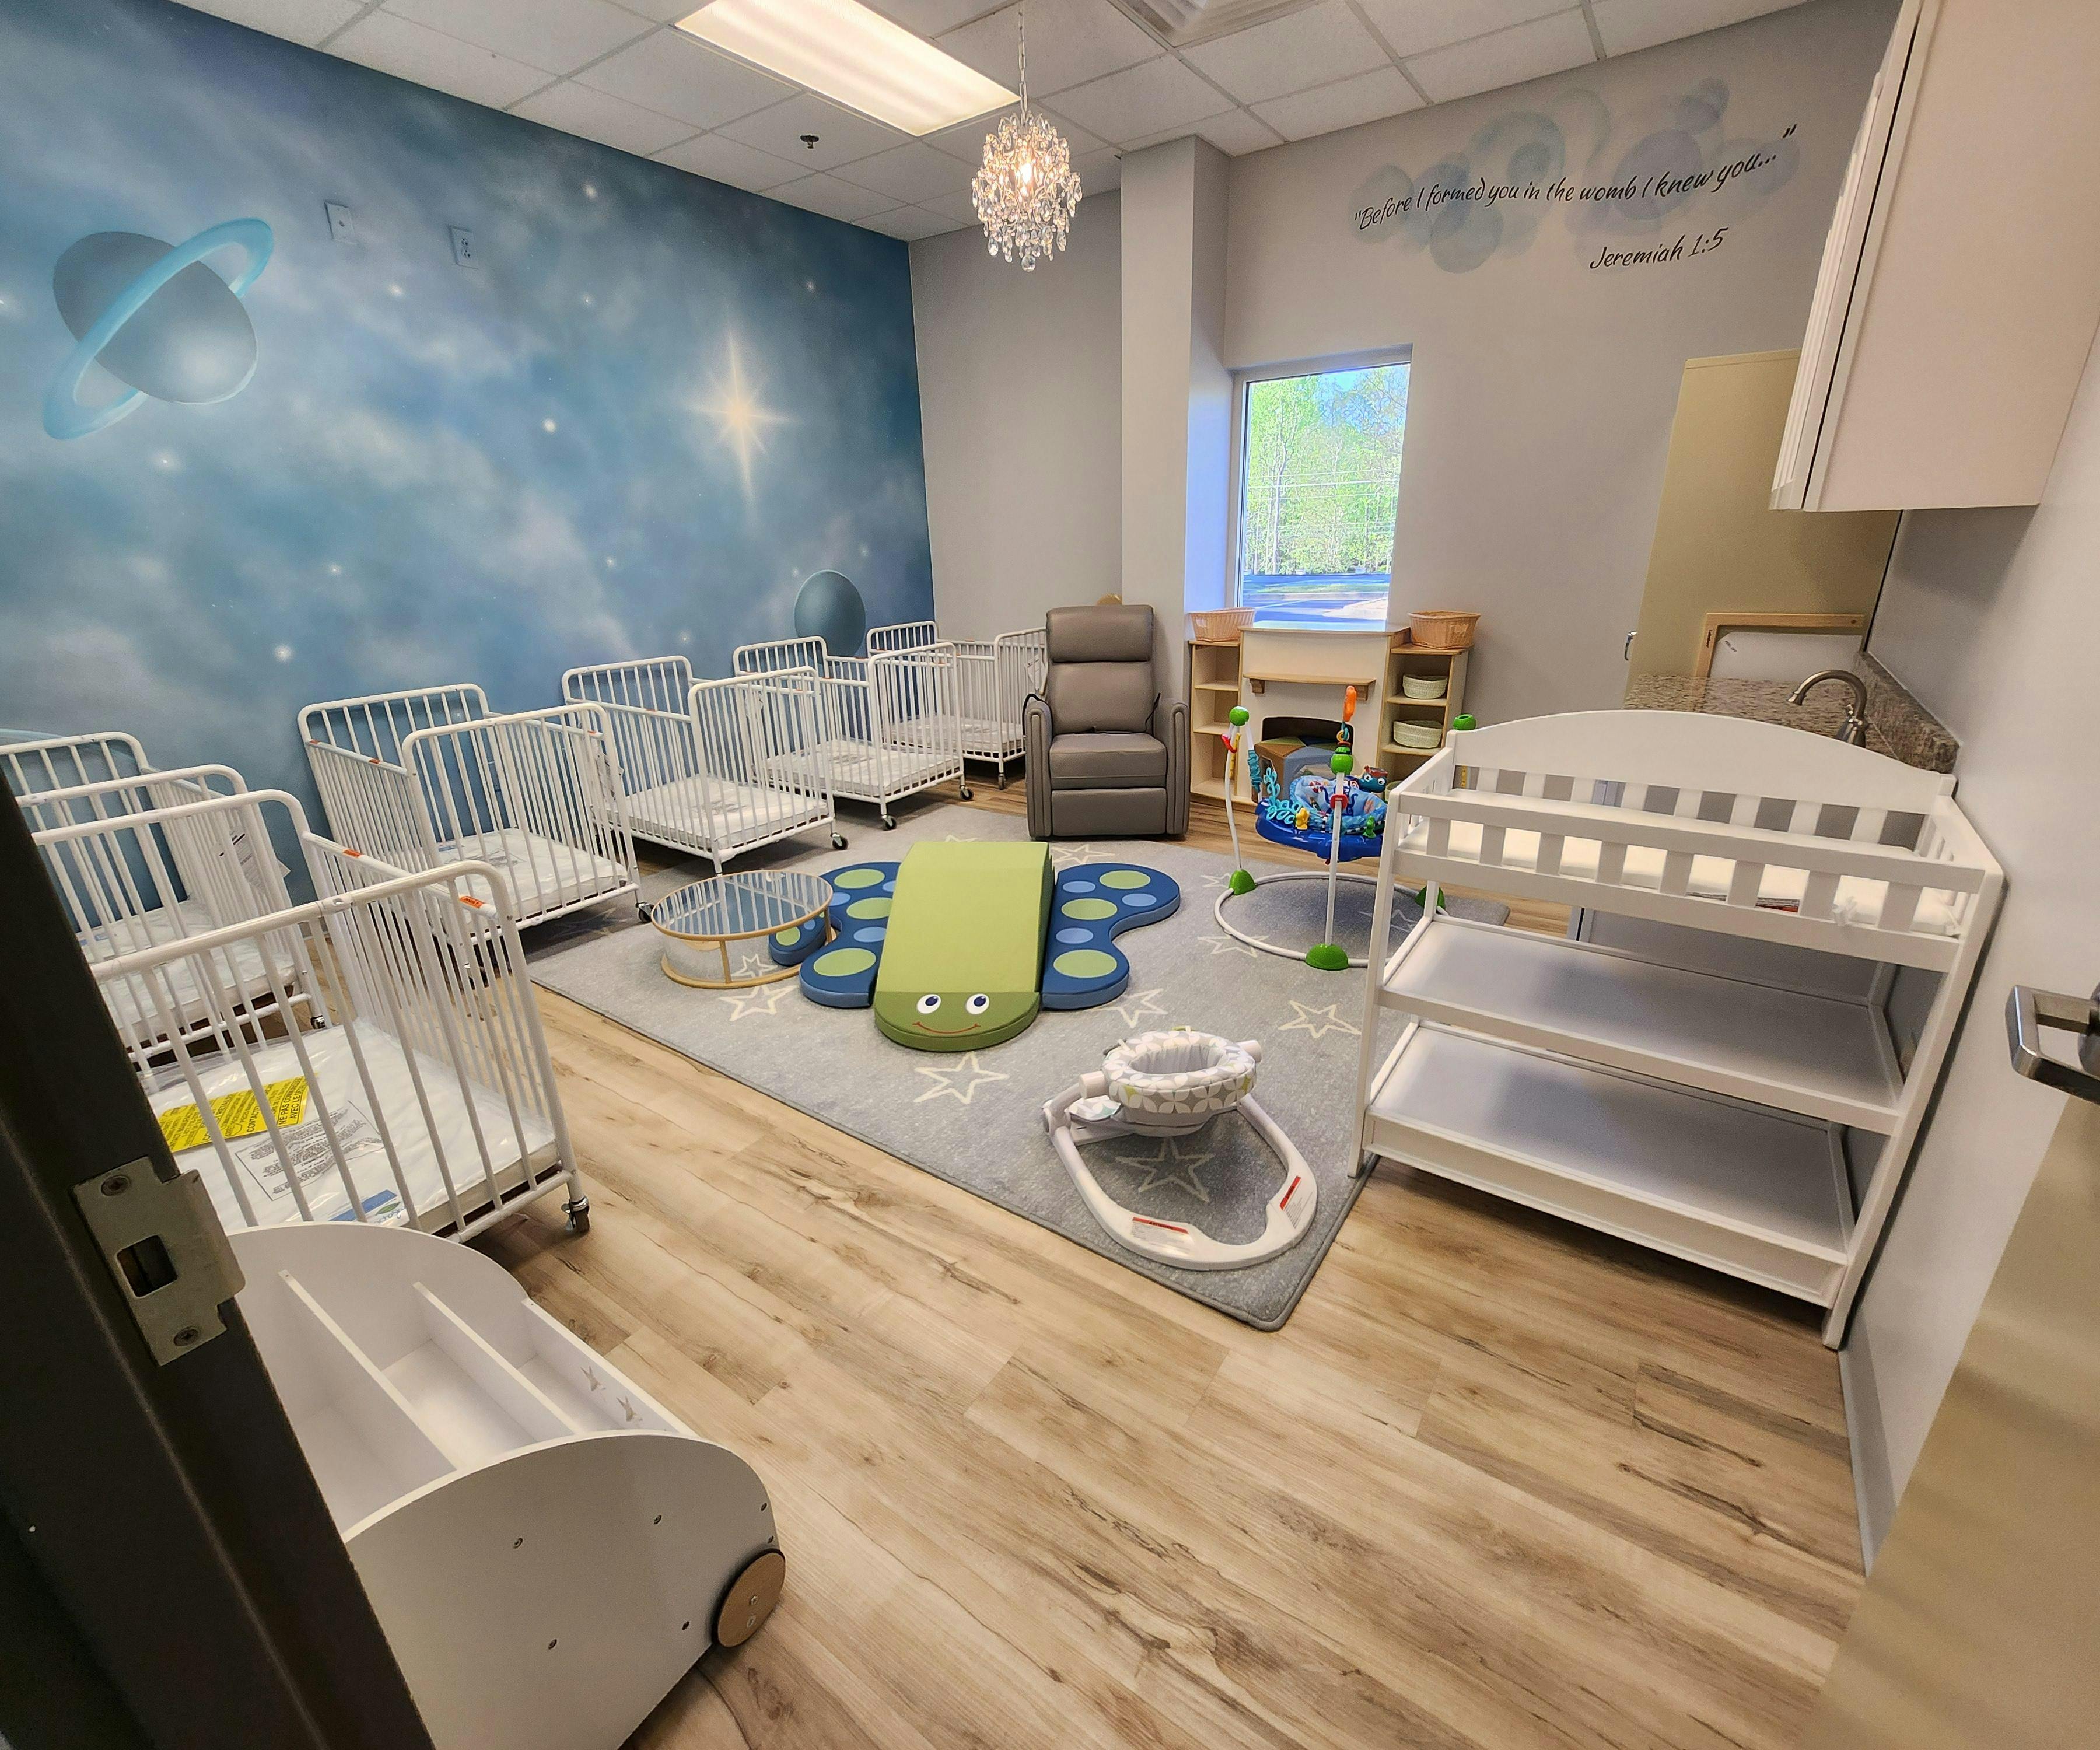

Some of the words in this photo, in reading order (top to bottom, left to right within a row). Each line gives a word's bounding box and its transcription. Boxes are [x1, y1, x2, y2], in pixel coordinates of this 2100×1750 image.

[1416, 187, 1424, 208] I
[1425, 177, 1485, 212] formed
[1485, 186, 1520, 208] you
[1524, 181, 1541, 200] in
[1546, 177, 1574, 202] the
[1579, 175, 1638, 201] womb
[1642, 177, 1653, 198] I
[1654, 170, 1714, 197] knew
[1590, 235, 1685, 270] Jeremiah
[1688, 227, 1729, 257] 1:5
[281, 1104, 290, 1116] PAS
[289, 1103, 299, 1119] AVEC
[278, 1116, 287, 1125] NE
